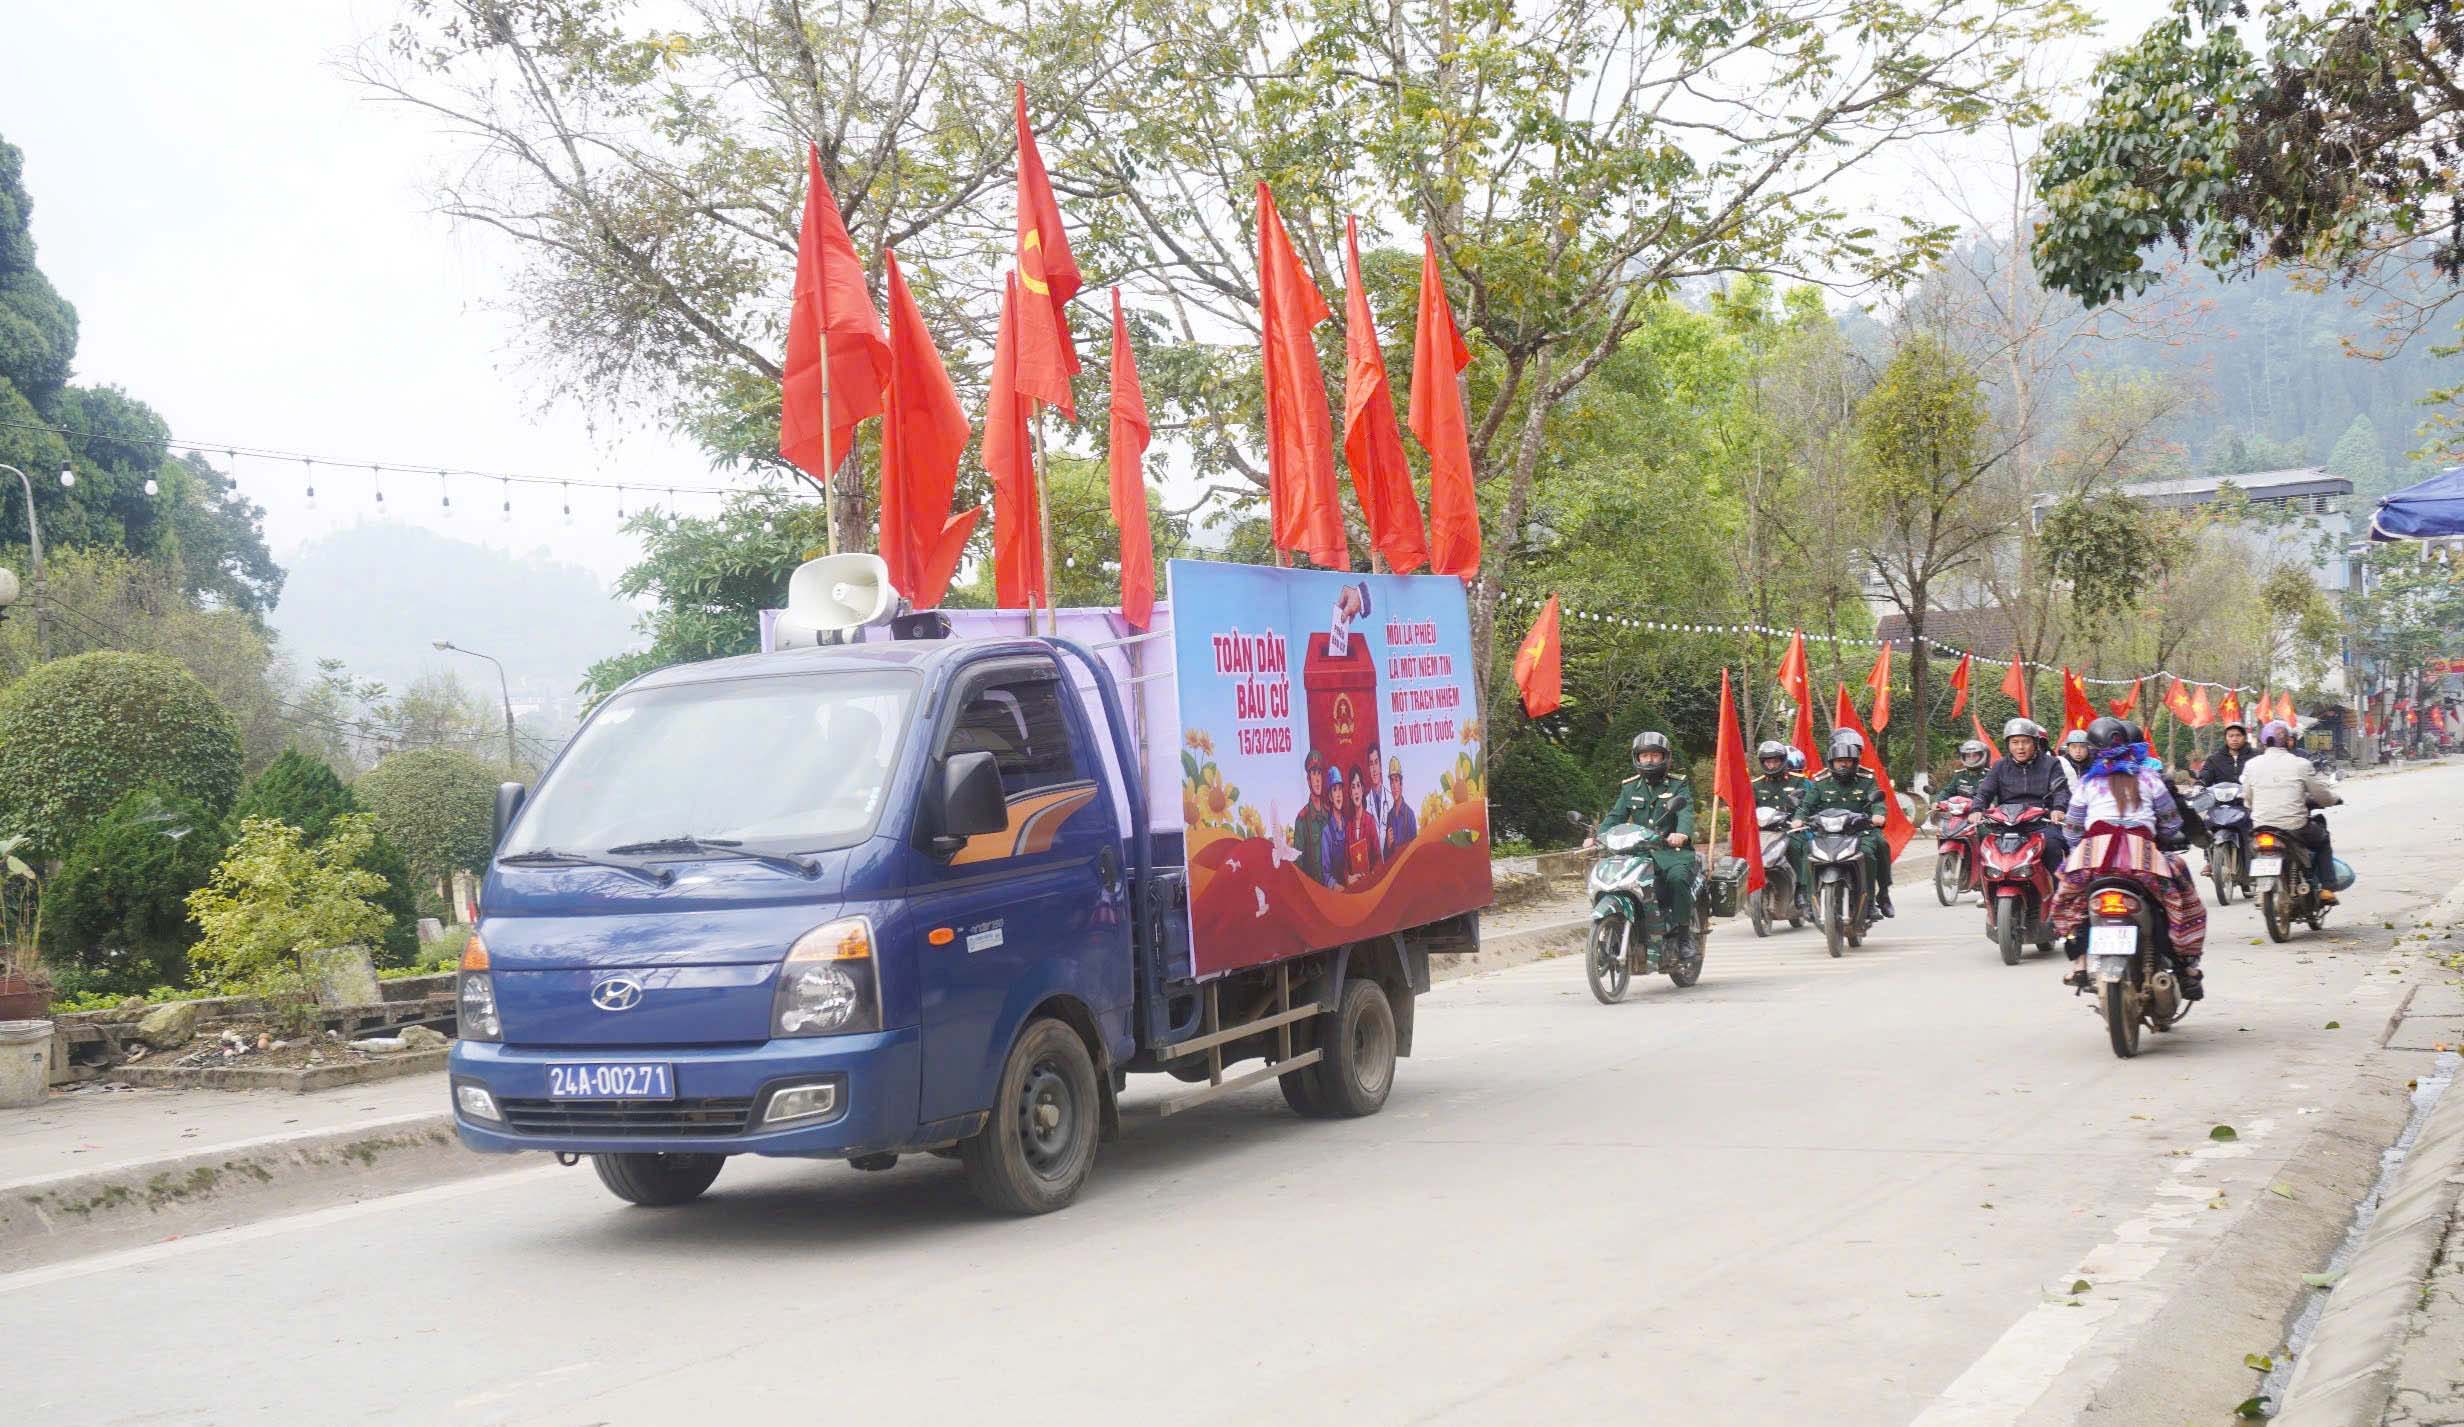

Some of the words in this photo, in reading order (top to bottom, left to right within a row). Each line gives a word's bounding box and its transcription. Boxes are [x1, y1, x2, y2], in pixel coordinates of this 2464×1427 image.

[1414, 616, 1437, 645] PHIẾU
[1213, 630, 1254, 673] TOÀN
[1256, 631, 1287, 673] DÂN
[1400, 653, 1417, 683] MỘT
[1419, 651, 1438, 678] NIỀM
[1439, 655, 1452, 676] TIN
[1236, 673, 1267, 719] BẦU
[1269, 673, 1290, 718] CỬ
[1391, 687, 1408, 716] MỘT
[1435, 683, 1460, 713] NHIỆM
[1237, 727, 1292, 756] 15/3/2026
[1408, 719, 1422, 745] VỚI
[1422, 713, 1433, 744] TỔ
[1434, 714, 1455, 743] QUỐC
[550, 1066, 667, 1096] 24A-002.71
